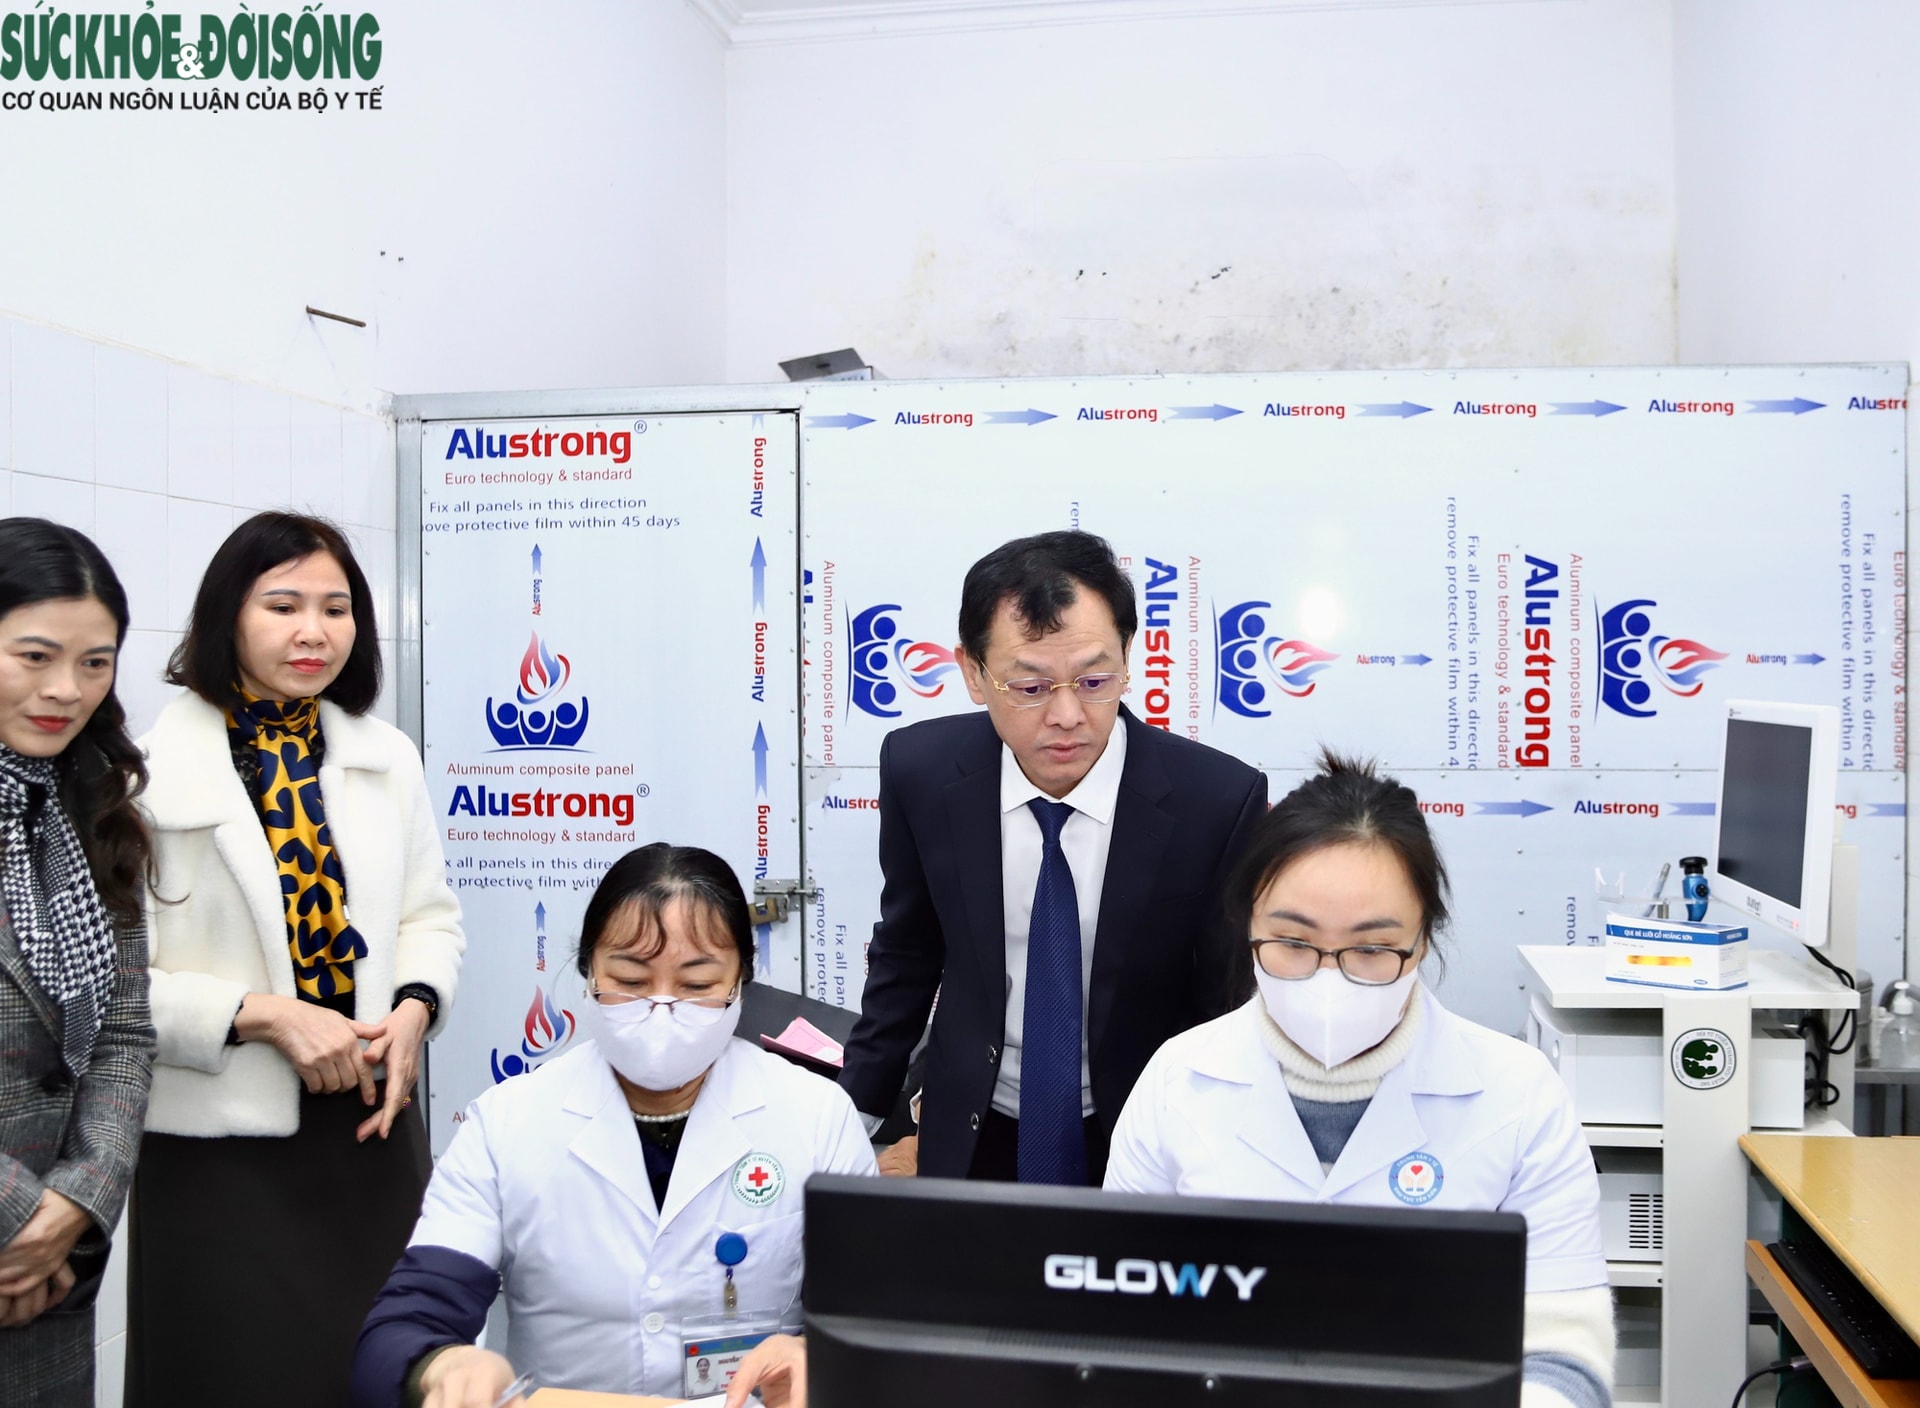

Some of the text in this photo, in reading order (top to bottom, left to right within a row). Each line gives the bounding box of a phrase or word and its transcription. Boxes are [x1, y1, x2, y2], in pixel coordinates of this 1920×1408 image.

[895, 412, 972, 426] Alustrong
[1077, 408, 1157, 422] Alustrong
[1264, 403, 1344, 419] Alustrong
[1454, 401, 1536, 417] Alustrong
[1649, 400, 1733, 416] Alustrong
[446, 468, 631, 485] Euro technology & standard
[751, 438, 766, 517] Alustrong
[430, 498, 646, 514] Fix all panels in this direction
[456, 520, 529, 533] protective
[536, 518, 562, 528] film
[569, 517, 615, 528] within
[622, 516, 640, 527] 45
[647, 515, 680, 529] days
[1447, 496, 1456, 559] remove
[1841, 494, 1850, 557] remove
[1468, 535, 1479, 557] Fix
[1863, 533, 1874, 555] Fix
[1468, 563, 1479, 582] all
[1863, 562, 1875, 581] all
[532, 579, 542, 615] Alustrong
[1189, 556, 1200, 633] Aluminum
[1445, 566, 1458, 652] protective
[1839, 564, 1853, 650] protective
[1466, 590, 1480, 644] panels
[1860, 588, 1875, 644] panels
[752, 623, 767, 702] Alustrong
[822, 560, 835, 765] Aluminum composite panel
[1357, 655, 1395, 666] Alustrong
[1468, 650, 1480, 666] in
[1496, 554, 1511, 768] Euro technology & standard
[1515, 554, 1559, 768] Alustrong
[1567, 554, 1583, 768] Aluminum composite panel
[1746, 654, 1787, 665] Alustrong
[1864, 650, 1875, 666] in
[1186, 639, 1200, 719] composite
[1448, 658, 1460, 690] film
[1468, 673, 1480, 703] this
[1842, 658, 1854, 690] film
[1864, 673, 1875, 703] this
[1449, 697, 1460, 750] within
[1842, 697, 1854, 751] within
[447, 763, 633, 778] Aluminum composite panel
[1574, 800, 1658, 817] Alustrong
[448, 829, 635, 844] Euro technology & standard
[457, 857, 472, 867] all
[479, 857, 525, 871] panels
[552, 858, 577, 869] this
[459, 876, 532, 888] protective
[539, 876, 566, 887] film
[817, 887, 825, 947] remove
[836, 925, 846, 945] Fix
[536, 936, 546, 971] Alustrong
[836, 952, 847, 969] all
[1044, 1253, 1268, 1301] GLOWY
